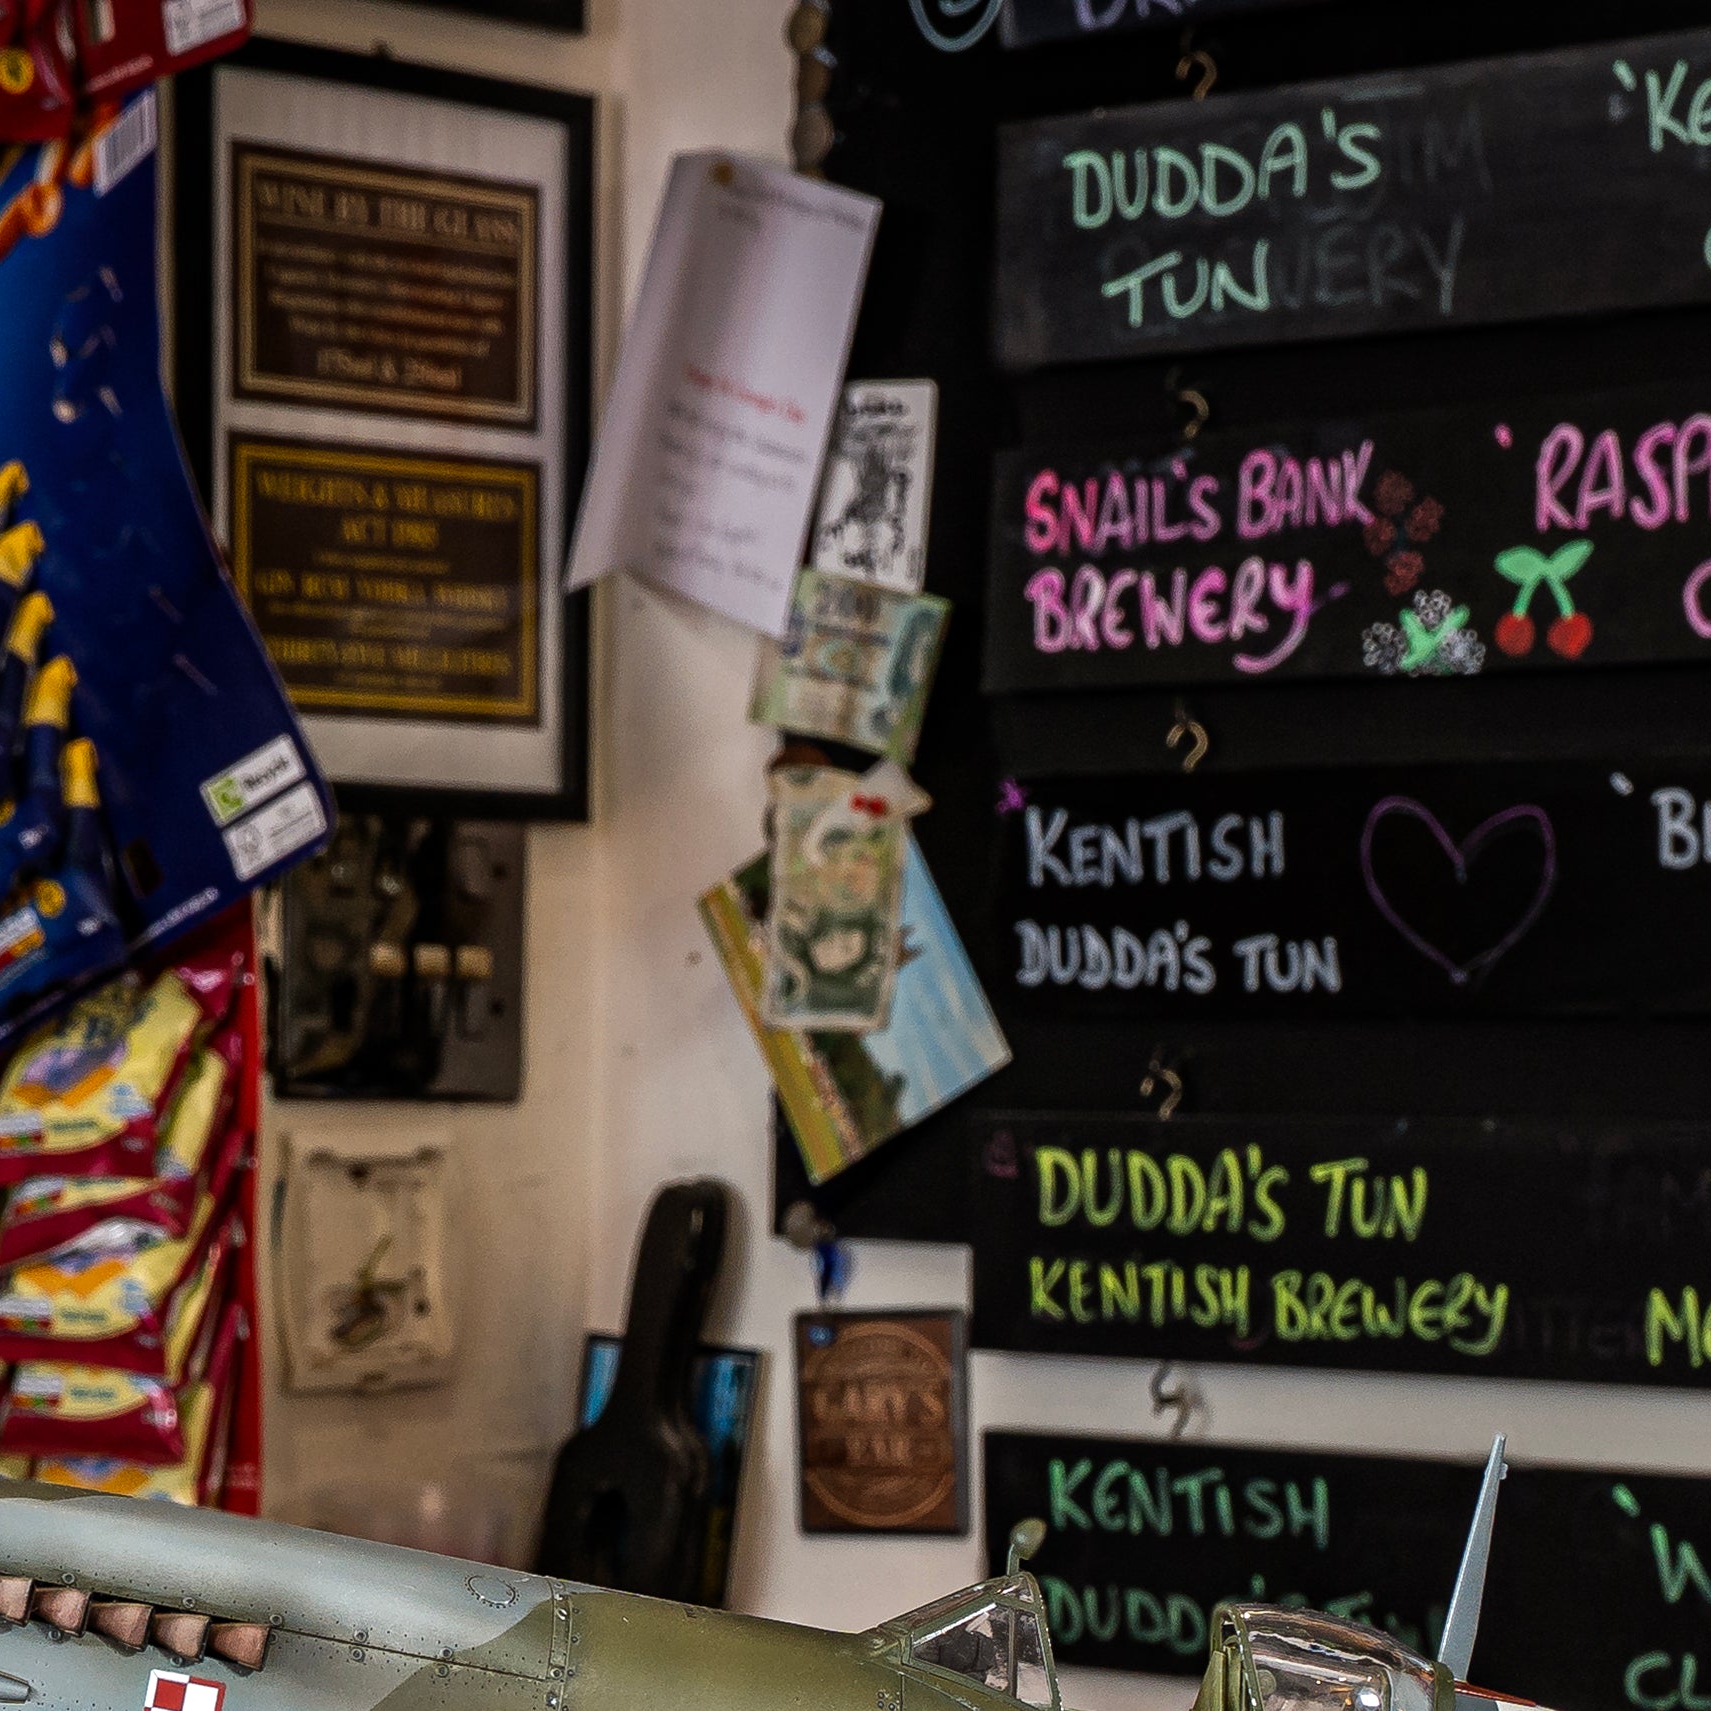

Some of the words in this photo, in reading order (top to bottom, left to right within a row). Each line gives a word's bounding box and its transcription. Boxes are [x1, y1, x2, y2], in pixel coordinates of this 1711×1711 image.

[1063, 107, 1382, 228] DUDDA'S
[1100, 238, 1270, 328] TUN
[1024, 457, 1221, 555] SNAIL'S
[1235, 437, 1376, 540] BANK
[1024, 554, 1316, 675] BREWERY
[1022, 804, 1287, 890] KENTISH
[1013, 916, 1218, 995] DUDDA'S
[1231, 931, 1344, 994] TUN
[1033, 1140, 1291, 1244] DUDDA'S
[1309, 1156, 1429, 1242] TUN
[1028, 1254, 1251, 1340] KENTISH
[1271, 1270, 1510, 1357] BREWERY
[1047, 1458, 1332, 1551] KENTISH
[1039, 1572, 1310, 1655] DUDD'
